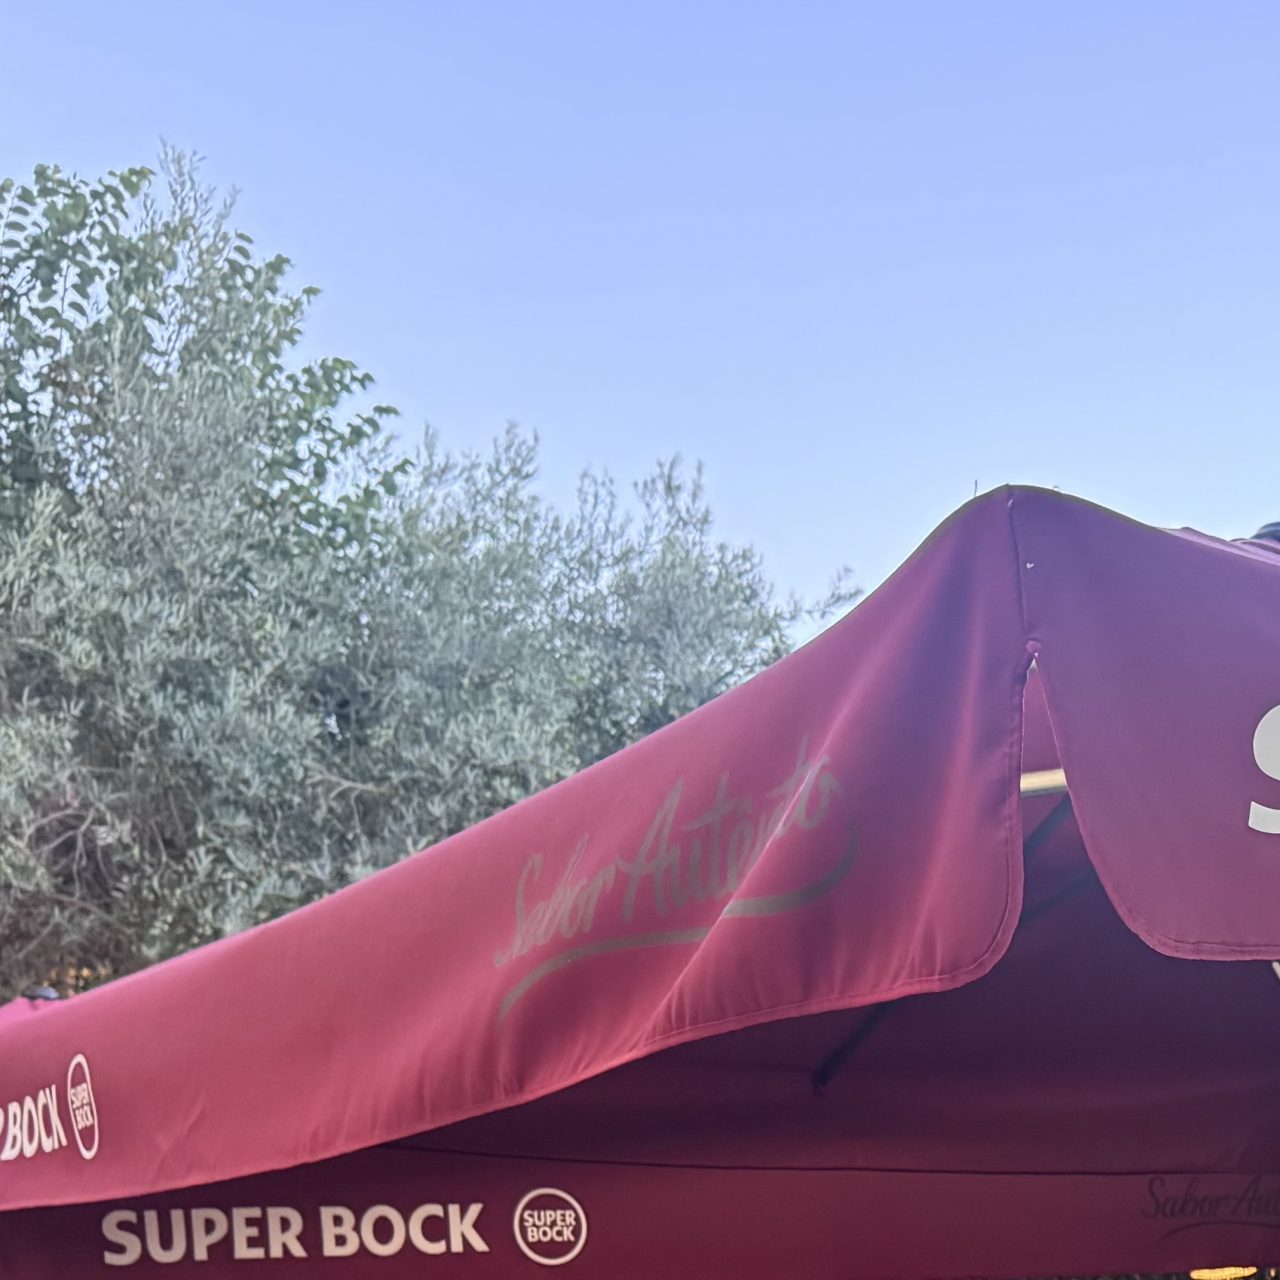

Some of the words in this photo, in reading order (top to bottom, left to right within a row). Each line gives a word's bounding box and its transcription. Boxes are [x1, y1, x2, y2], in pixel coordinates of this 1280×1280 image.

[0, 1084, 68, 1161] BOCK
[102, 1207, 307, 1266] SUPER
[320, 1203, 490, 1257] BOCK
[523, 1209, 576, 1227] SUPER
[527, 1226, 575, 1242] BOCK
